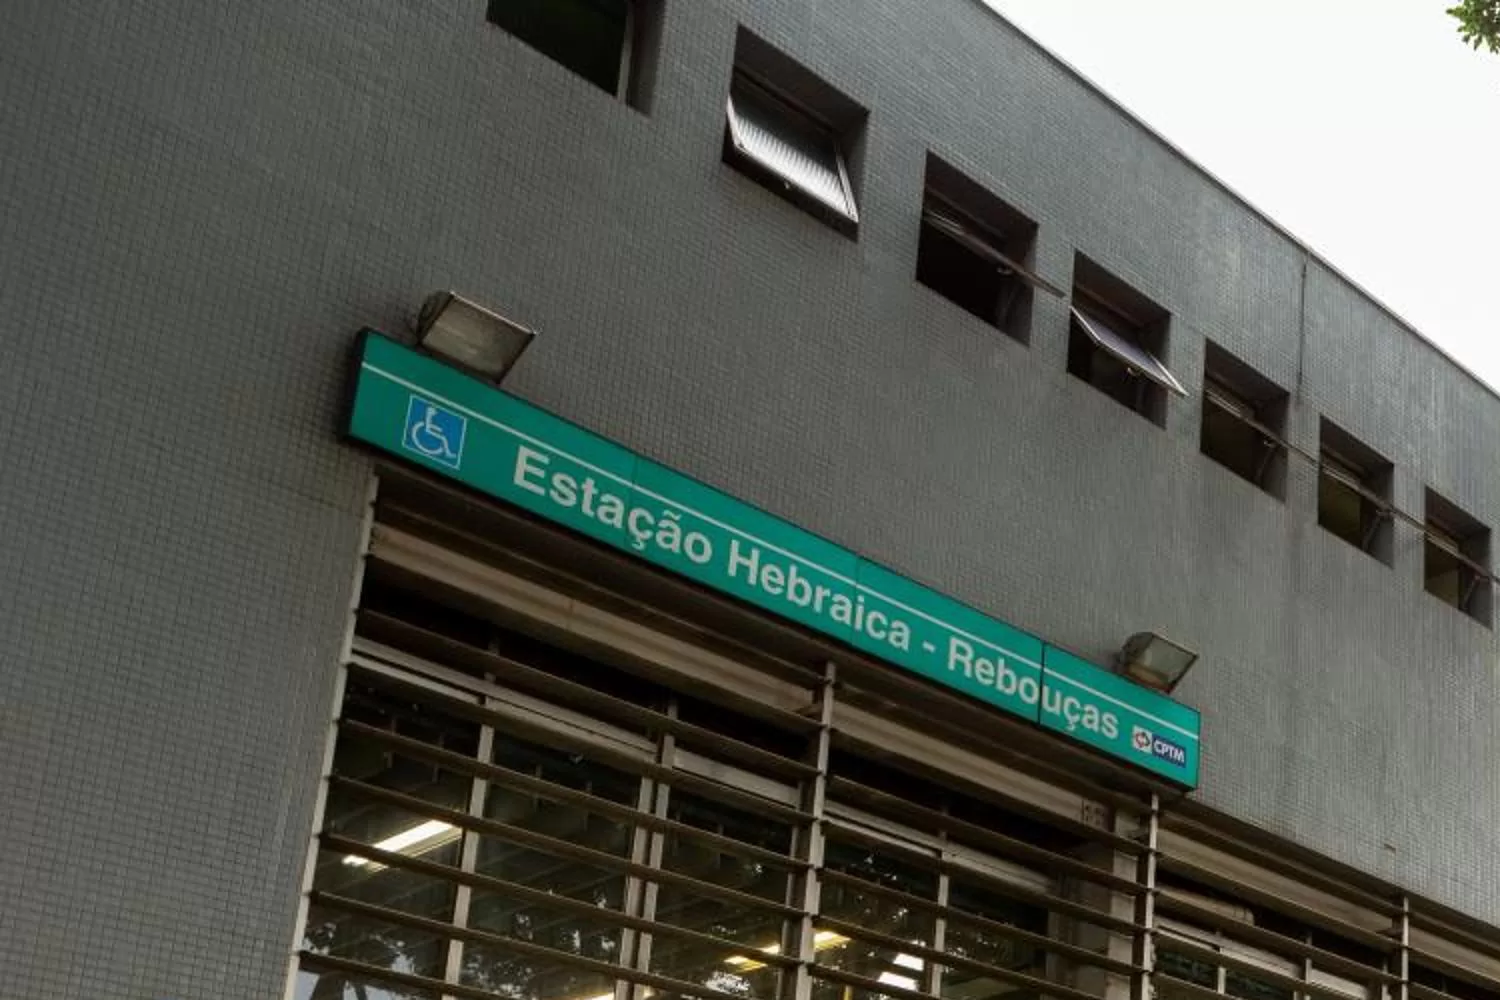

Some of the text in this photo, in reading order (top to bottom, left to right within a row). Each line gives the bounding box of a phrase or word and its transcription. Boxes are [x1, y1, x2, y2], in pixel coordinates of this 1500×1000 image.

[513, 445, 713, 564] Estação
[727, 538, 911, 652] Hebraica
[946, 636, 1119, 740] Rebouças
[1153, 739, 1185, 764] CPTM
